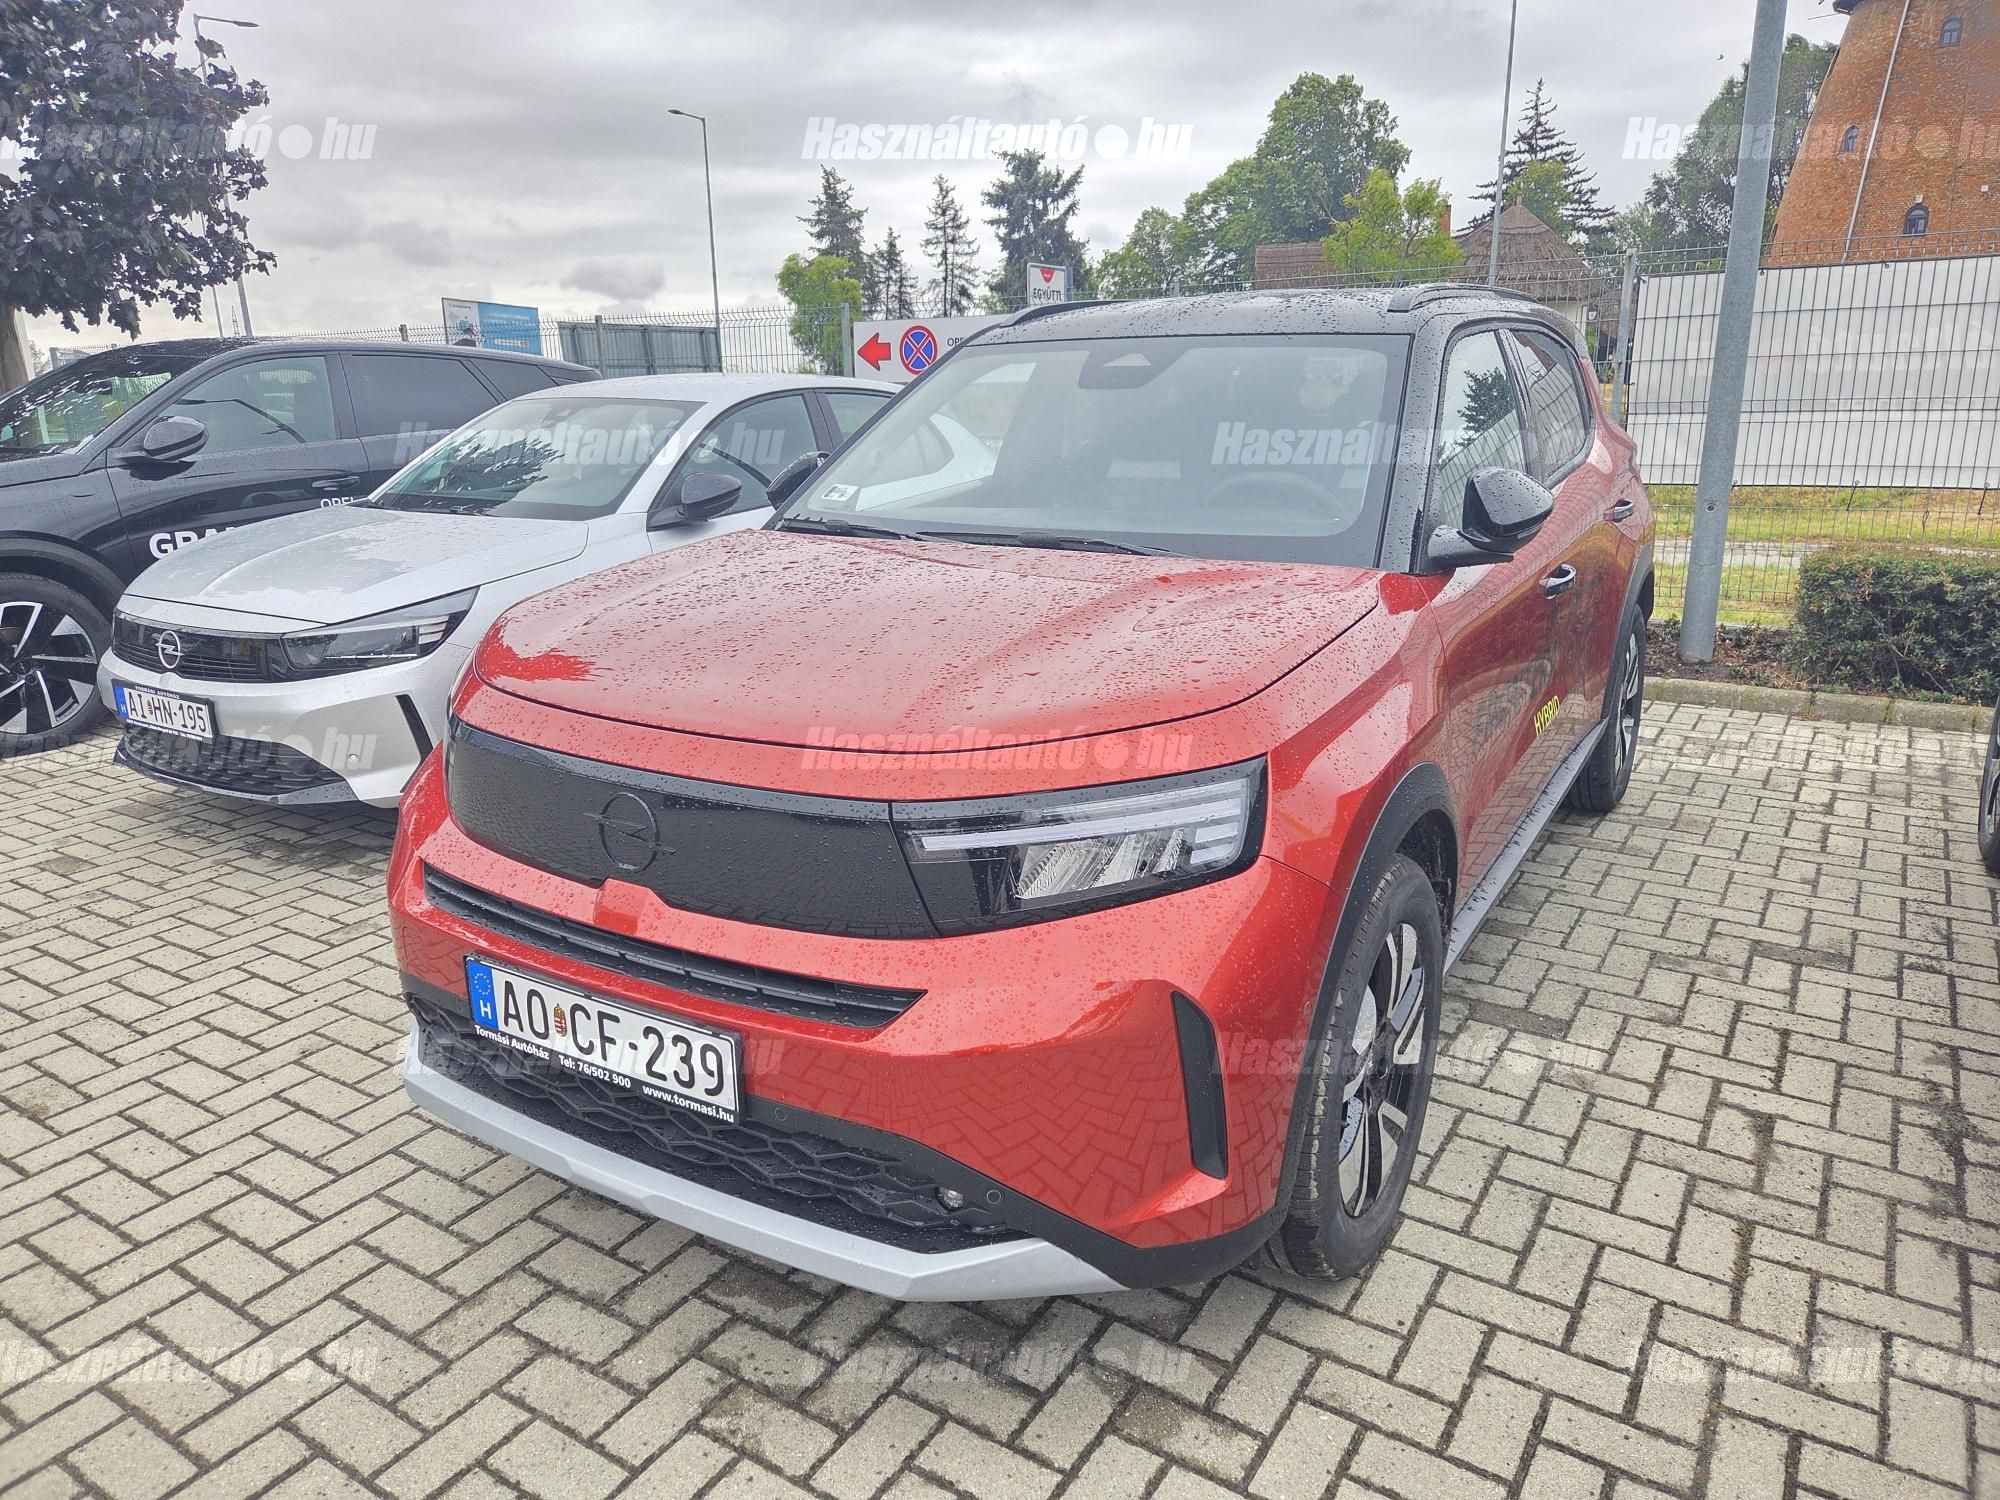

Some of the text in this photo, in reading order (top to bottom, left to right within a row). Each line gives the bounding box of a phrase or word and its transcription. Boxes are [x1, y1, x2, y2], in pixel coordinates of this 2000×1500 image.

[120, 703, 127, 713] H
[1533, 695, 1561, 737] HYBRID
[479, 999, 493, 1021] H
[474, 1024, 735, 1123] Tormási Autóház Tel: 76/502 900 www.tormasi.hu
